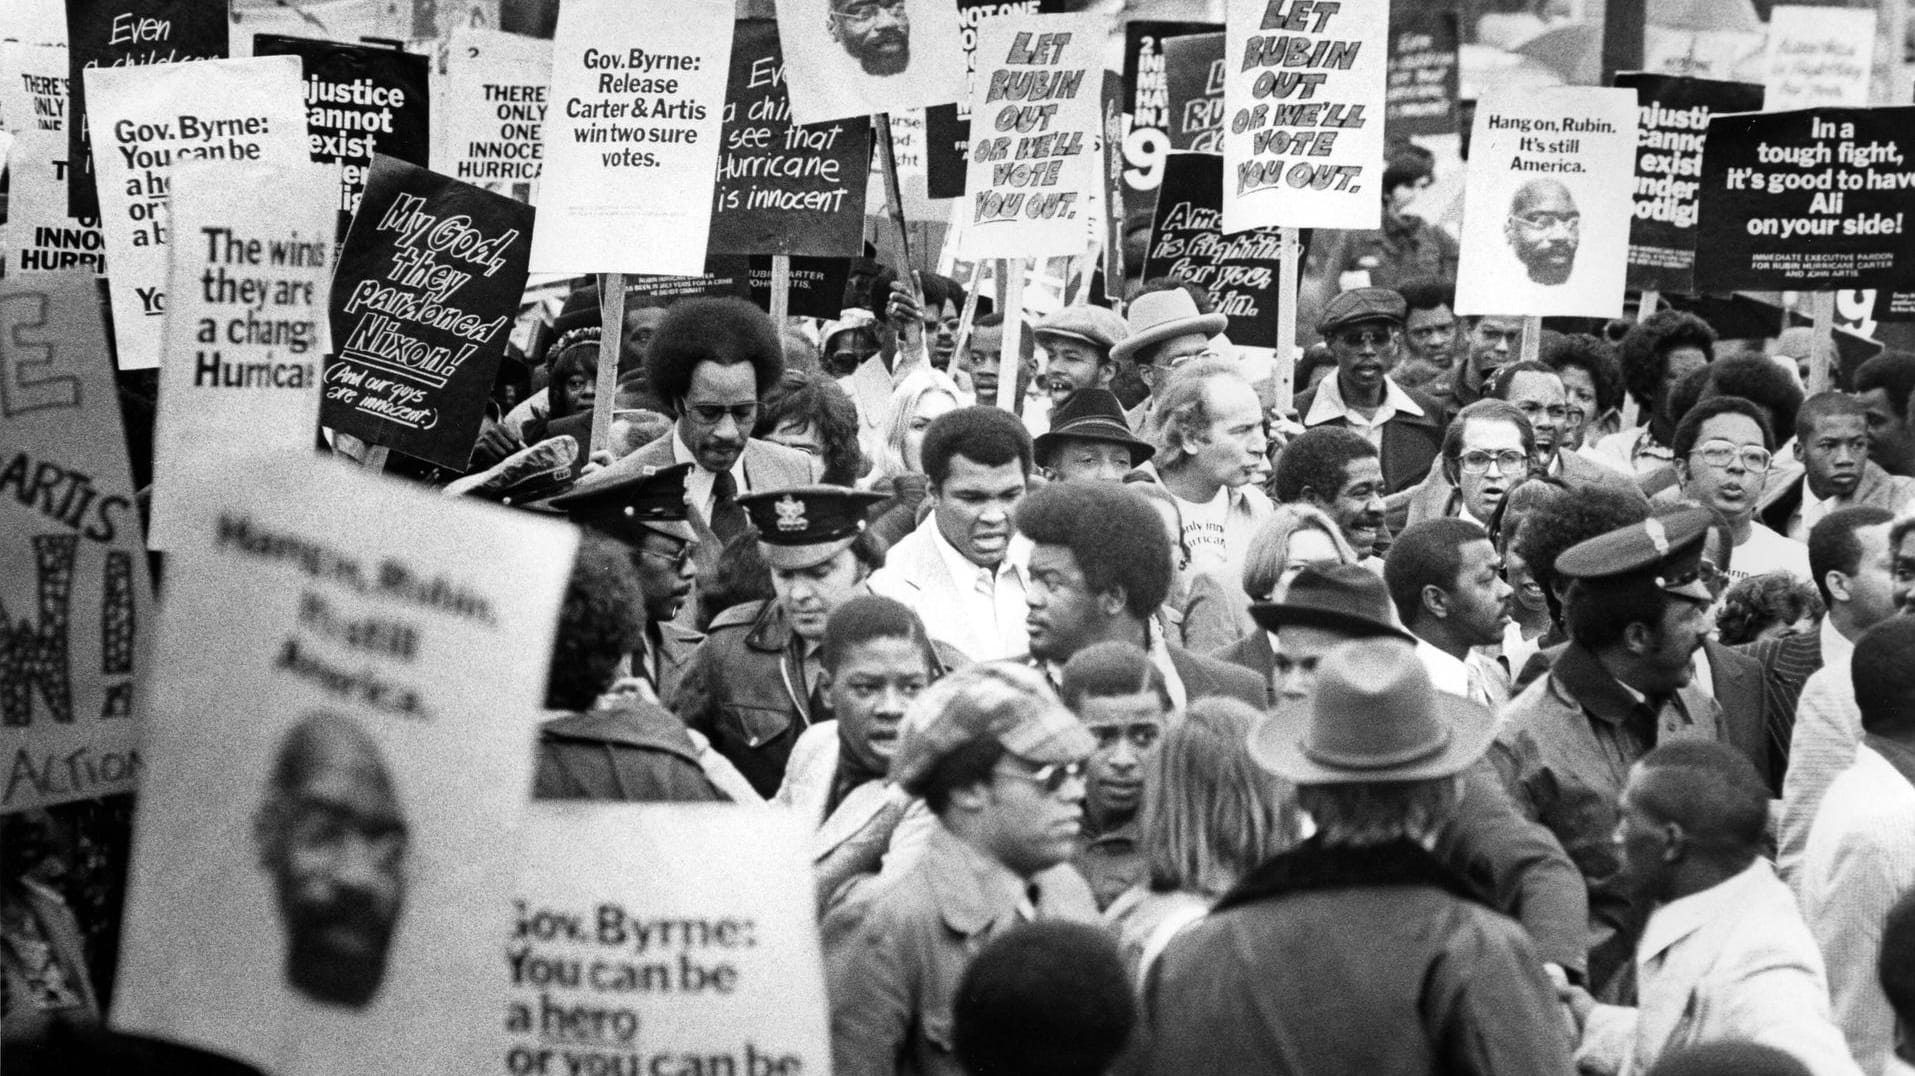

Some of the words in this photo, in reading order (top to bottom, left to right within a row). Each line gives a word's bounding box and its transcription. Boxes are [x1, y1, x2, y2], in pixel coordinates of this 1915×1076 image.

[108, 12, 171, 46] Even
[1260, 0, 1342, 33] LET
[584, 48, 625, 69] Gov.
[628, 48, 701, 73] Byrne:
[1006, 31, 1072, 65] LET
[1240, 36, 1362, 73] RUBIN
[599, 73, 678, 94] Release
[747, 57, 788, 88] Ev
[1252, 71, 1327, 100] OUT
[482, 84, 546, 102] THERE
[985, 69, 1085, 104] RUBIN
[497, 104, 548, 122] ONLY
[566, 98, 630, 118] Carter
[631, 97, 648, 118] &
[651, 98, 707, 120] Artis
[723, 102, 737, 123] a
[994, 103, 1058, 133] OUT
[1231, 103, 1269, 135] OR
[1273, 101, 1366, 129] WE'LL
[114, 119, 176, 144] Gov.
[178, 115, 269, 142] Byrne:
[501, 123, 542, 140] ONE
[574, 122, 607, 143] win
[611, 123, 645, 143] two
[648, 128, 698, 144] sure
[1488, 114, 1530, 132] Hang
[1534, 119, 1560, 133] on,
[1562, 117, 1617, 133] Rubin.
[1811, 116, 1836, 139] In
[1839, 122, 1855, 139] a
[309, 130, 377, 158] exist
[468, 142, 543, 159] INNOCE
[728, 127, 771, 149] see
[784, 124, 843, 151] that
[974, 136, 1012, 163] OR
[1253, 129, 1339, 156] VOTE
[1520, 137, 1546, 153] It's
[1549, 138, 1581, 153] still
[119, 144, 173, 170] You
[228, 138, 262, 161] be
[602, 147, 660, 168] votes.
[716, 151, 841, 183] Hurricane
[1510, 155, 1587, 174] America.
[1757, 141, 1832, 168] tough
[1838, 141, 1904, 168] fight,
[126, 178, 142, 196] a
[993, 159, 1063, 188] VOTE
[1237, 160, 1285, 196] YOU
[1286, 161, 1363, 194] OUT.
[1726, 167, 1767, 190] it's
[1767, 168, 1833, 194] good
[1836, 170, 1863, 190] to
[718, 186, 740, 212] is
[747, 185, 848, 212] innocent
[974, 190, 1026, 223] YOU
[1025, 191, 1078, 220] OUT.
[1808, 192, 1843, 214] Ali
[35, 227, 106, 250] INNO
[132, 227, 149, 246] a
[376, 193, 436, 248] My
[428, 215, 519, 277] God,
[1747, 218, 1779, 235] on
[1780, 218, 1839, 239] your
[1843, 213, 1904, 235] side!
[201, 226, 262, 264] The
[1152, 233, 1184, 258] is
[1752, 253, 1802, 262] IMMEDIATE
[1804, 253, 1855, 262] EXECUTIVE
[1857, 252, 1894, 261] PARDON
[388, 247, 472, 303] they
[1751, 262, 1770, 271] FOR
[1772, 262, 1801, 271] RUBIN
[1802, 262, 1854, 271] HURRICANE
[1856, 261, 1893, 269] CARTER
[1785, 270, 1805, 278] AND
[1832, 269, 1860, 278] ARTIS
[201, 267, 269, 311] they
[344, 280, 508, 343] pardoned
[198, 317, 217, 344] a
[344, 312, 479, 377] Nixon!
[326, 386, 358, 403] are
[365, 377, 395, 392] our
[389, 384, 429, 406] guys
[0, 454, 130, 543] ARTIS
[598, 902, 756, 953] Byrne:
[506, 945, 583, 990] You
[590, 961, 672, 993] can
[680, 955, 739, 993] be
[505, 1003, 533, 1034] a
[541, 993, 638, 1042] hero
[649, 1051, 738, 1076] can
